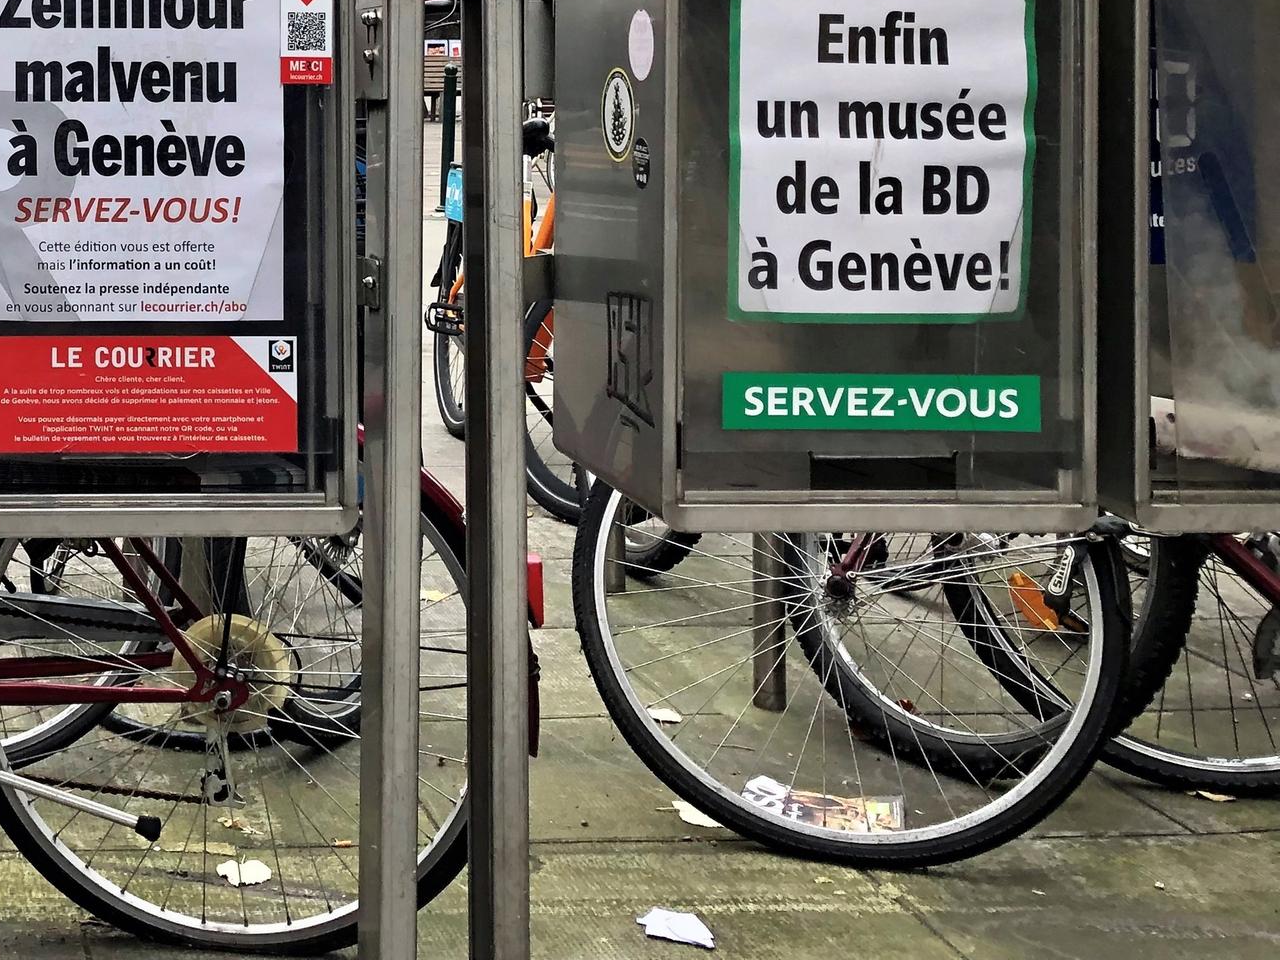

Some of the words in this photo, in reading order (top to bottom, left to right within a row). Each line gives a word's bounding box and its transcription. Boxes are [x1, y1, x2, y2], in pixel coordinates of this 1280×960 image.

[818, 11, 948, 65] Enfin
[15, 46, 237, 102] malvenu
[758, 101, 819, 138] un
[839, 89, 1006, 140] musée
[8, 119, 37, 176] à
[54, 119, 245, 176] Genève
[777, 161, 839, 214] de
[859, 161, 902, 215] la
[923, 165, 989, 214] BD
[15, 197, 241, 223] SERVEZ-VOUS!
[38, 240, 72, 254] Cette
[74, 240, 117, 253] édition
[120, 243, 149, 253] vous
[151, 241, 171, 253] est
[173, 240, 215, 253] offerte
[37, 259, 66, 273] mais
[69, 258, 151, 271] l'information
[153, 261, 161, 271] a
[164, 261, 181, 271] un
[184, 258, 216, 271] coût!
[748, 237, 777, 289] à
[798, 238, 1010, 291] Genève!
[23, 281, 82, 296] Soutenez
[84, 282, 96, 294] la
[99, 284, 140, 297] presse
[142, 282, 230, 297] indépendante
[5, 302, 22, 314] en
[23, 302, 54, 314] vous
[55, 298, 115, 314] abonnant
[118, 303, 138, 313] sur
[140, 299, 248, 315] lecourrier.ch/abo
[51, 347, 83, 368] LE
[95, 347, 216, 368] COURRIER
[745, 387, 1018, 418] SERVEZ-VOUS
